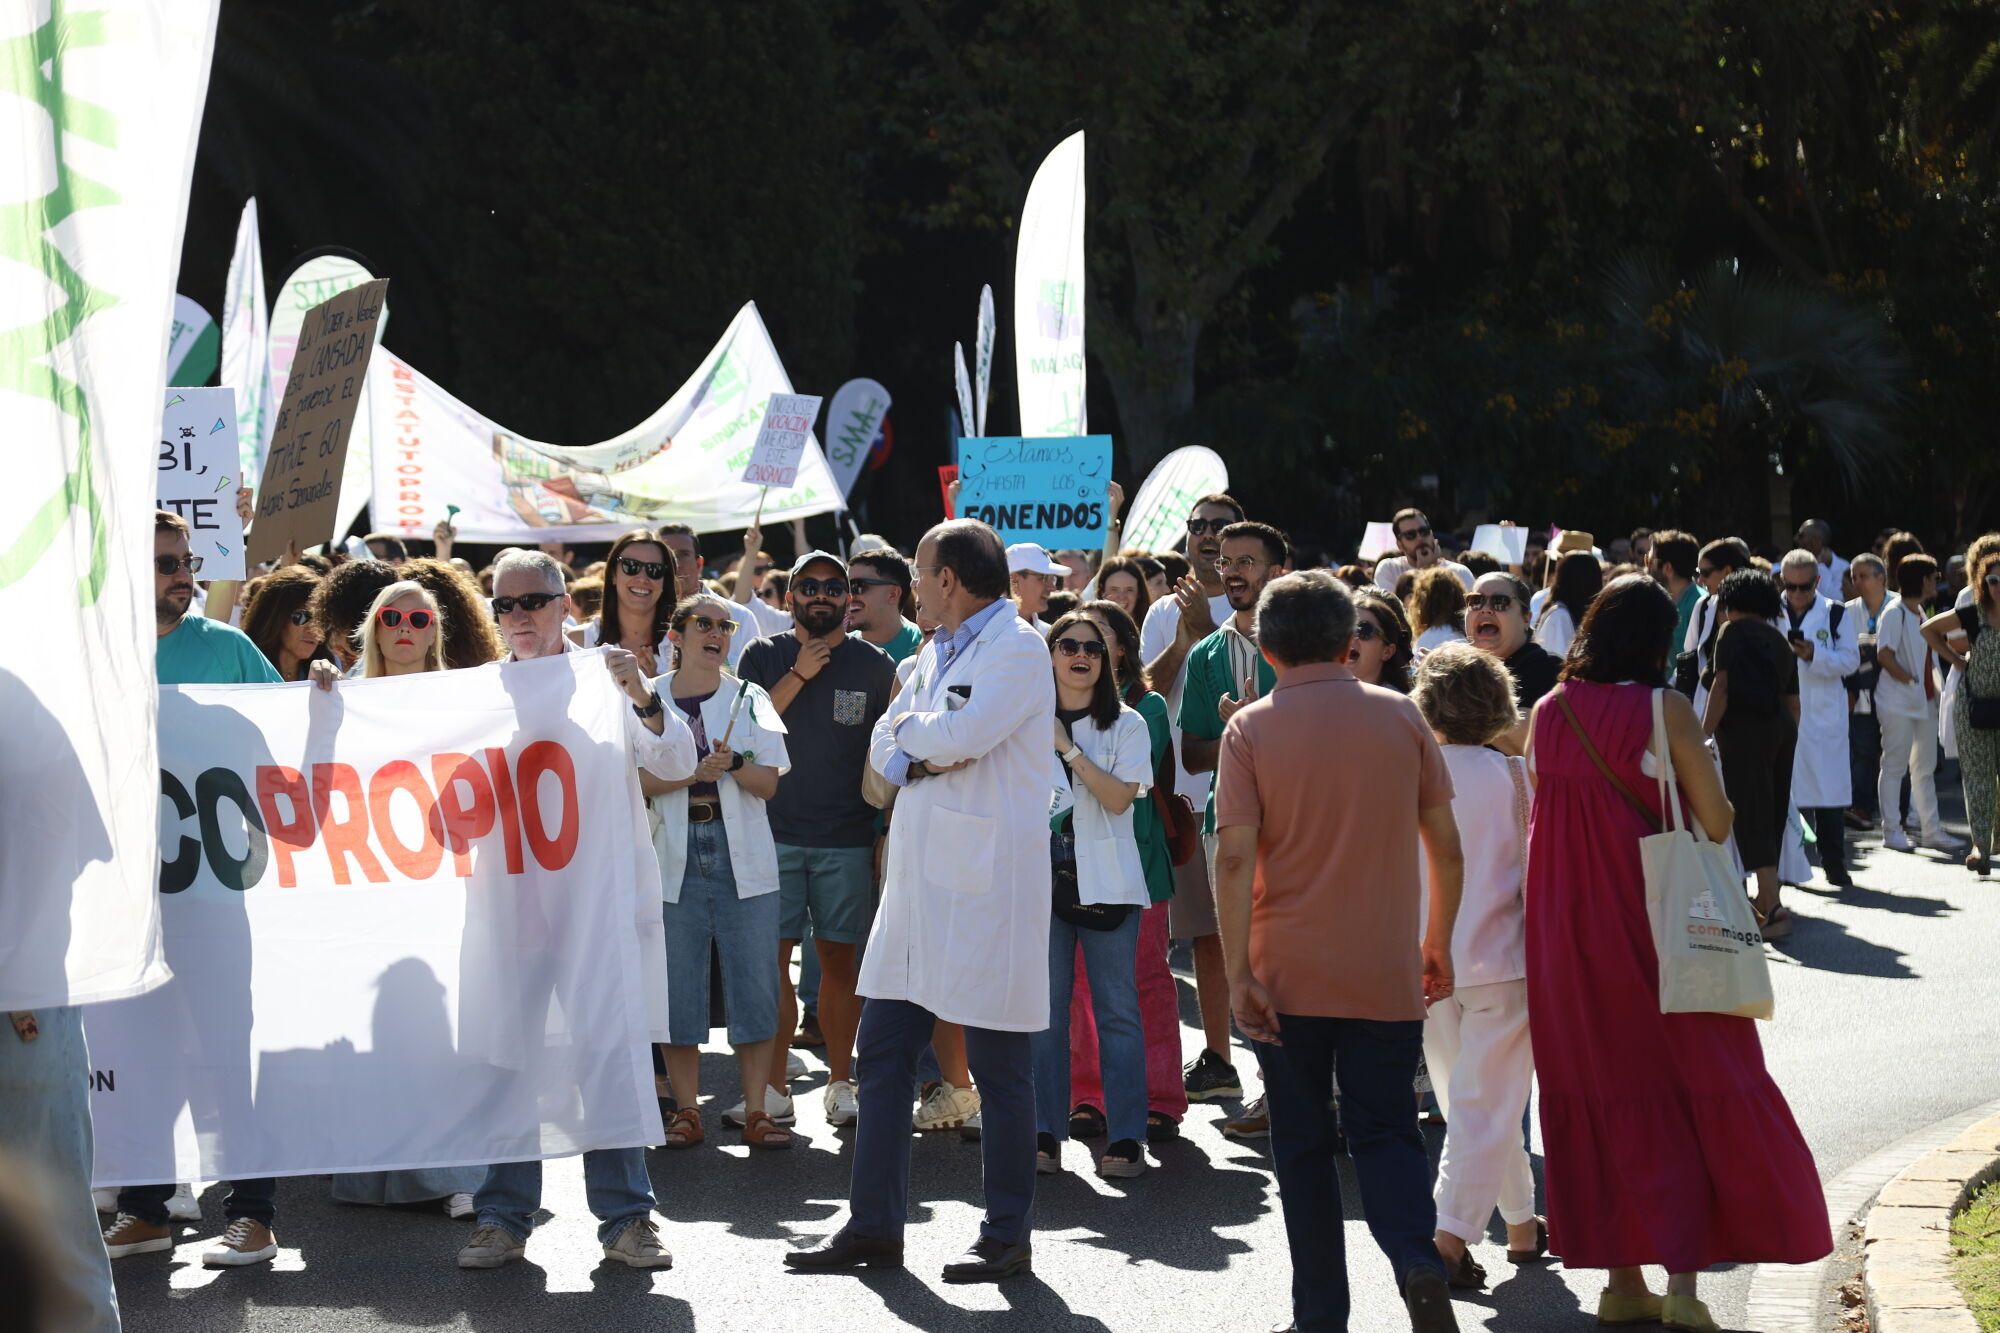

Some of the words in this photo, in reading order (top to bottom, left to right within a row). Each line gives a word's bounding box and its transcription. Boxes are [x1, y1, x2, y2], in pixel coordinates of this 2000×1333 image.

[700, 400, 769, 452] SINDICAT
[983, 439, 1074, 464] Estamos
[985, 474, 1026, 491] HASTA
[1052, 474, 1075, 490] LOS
